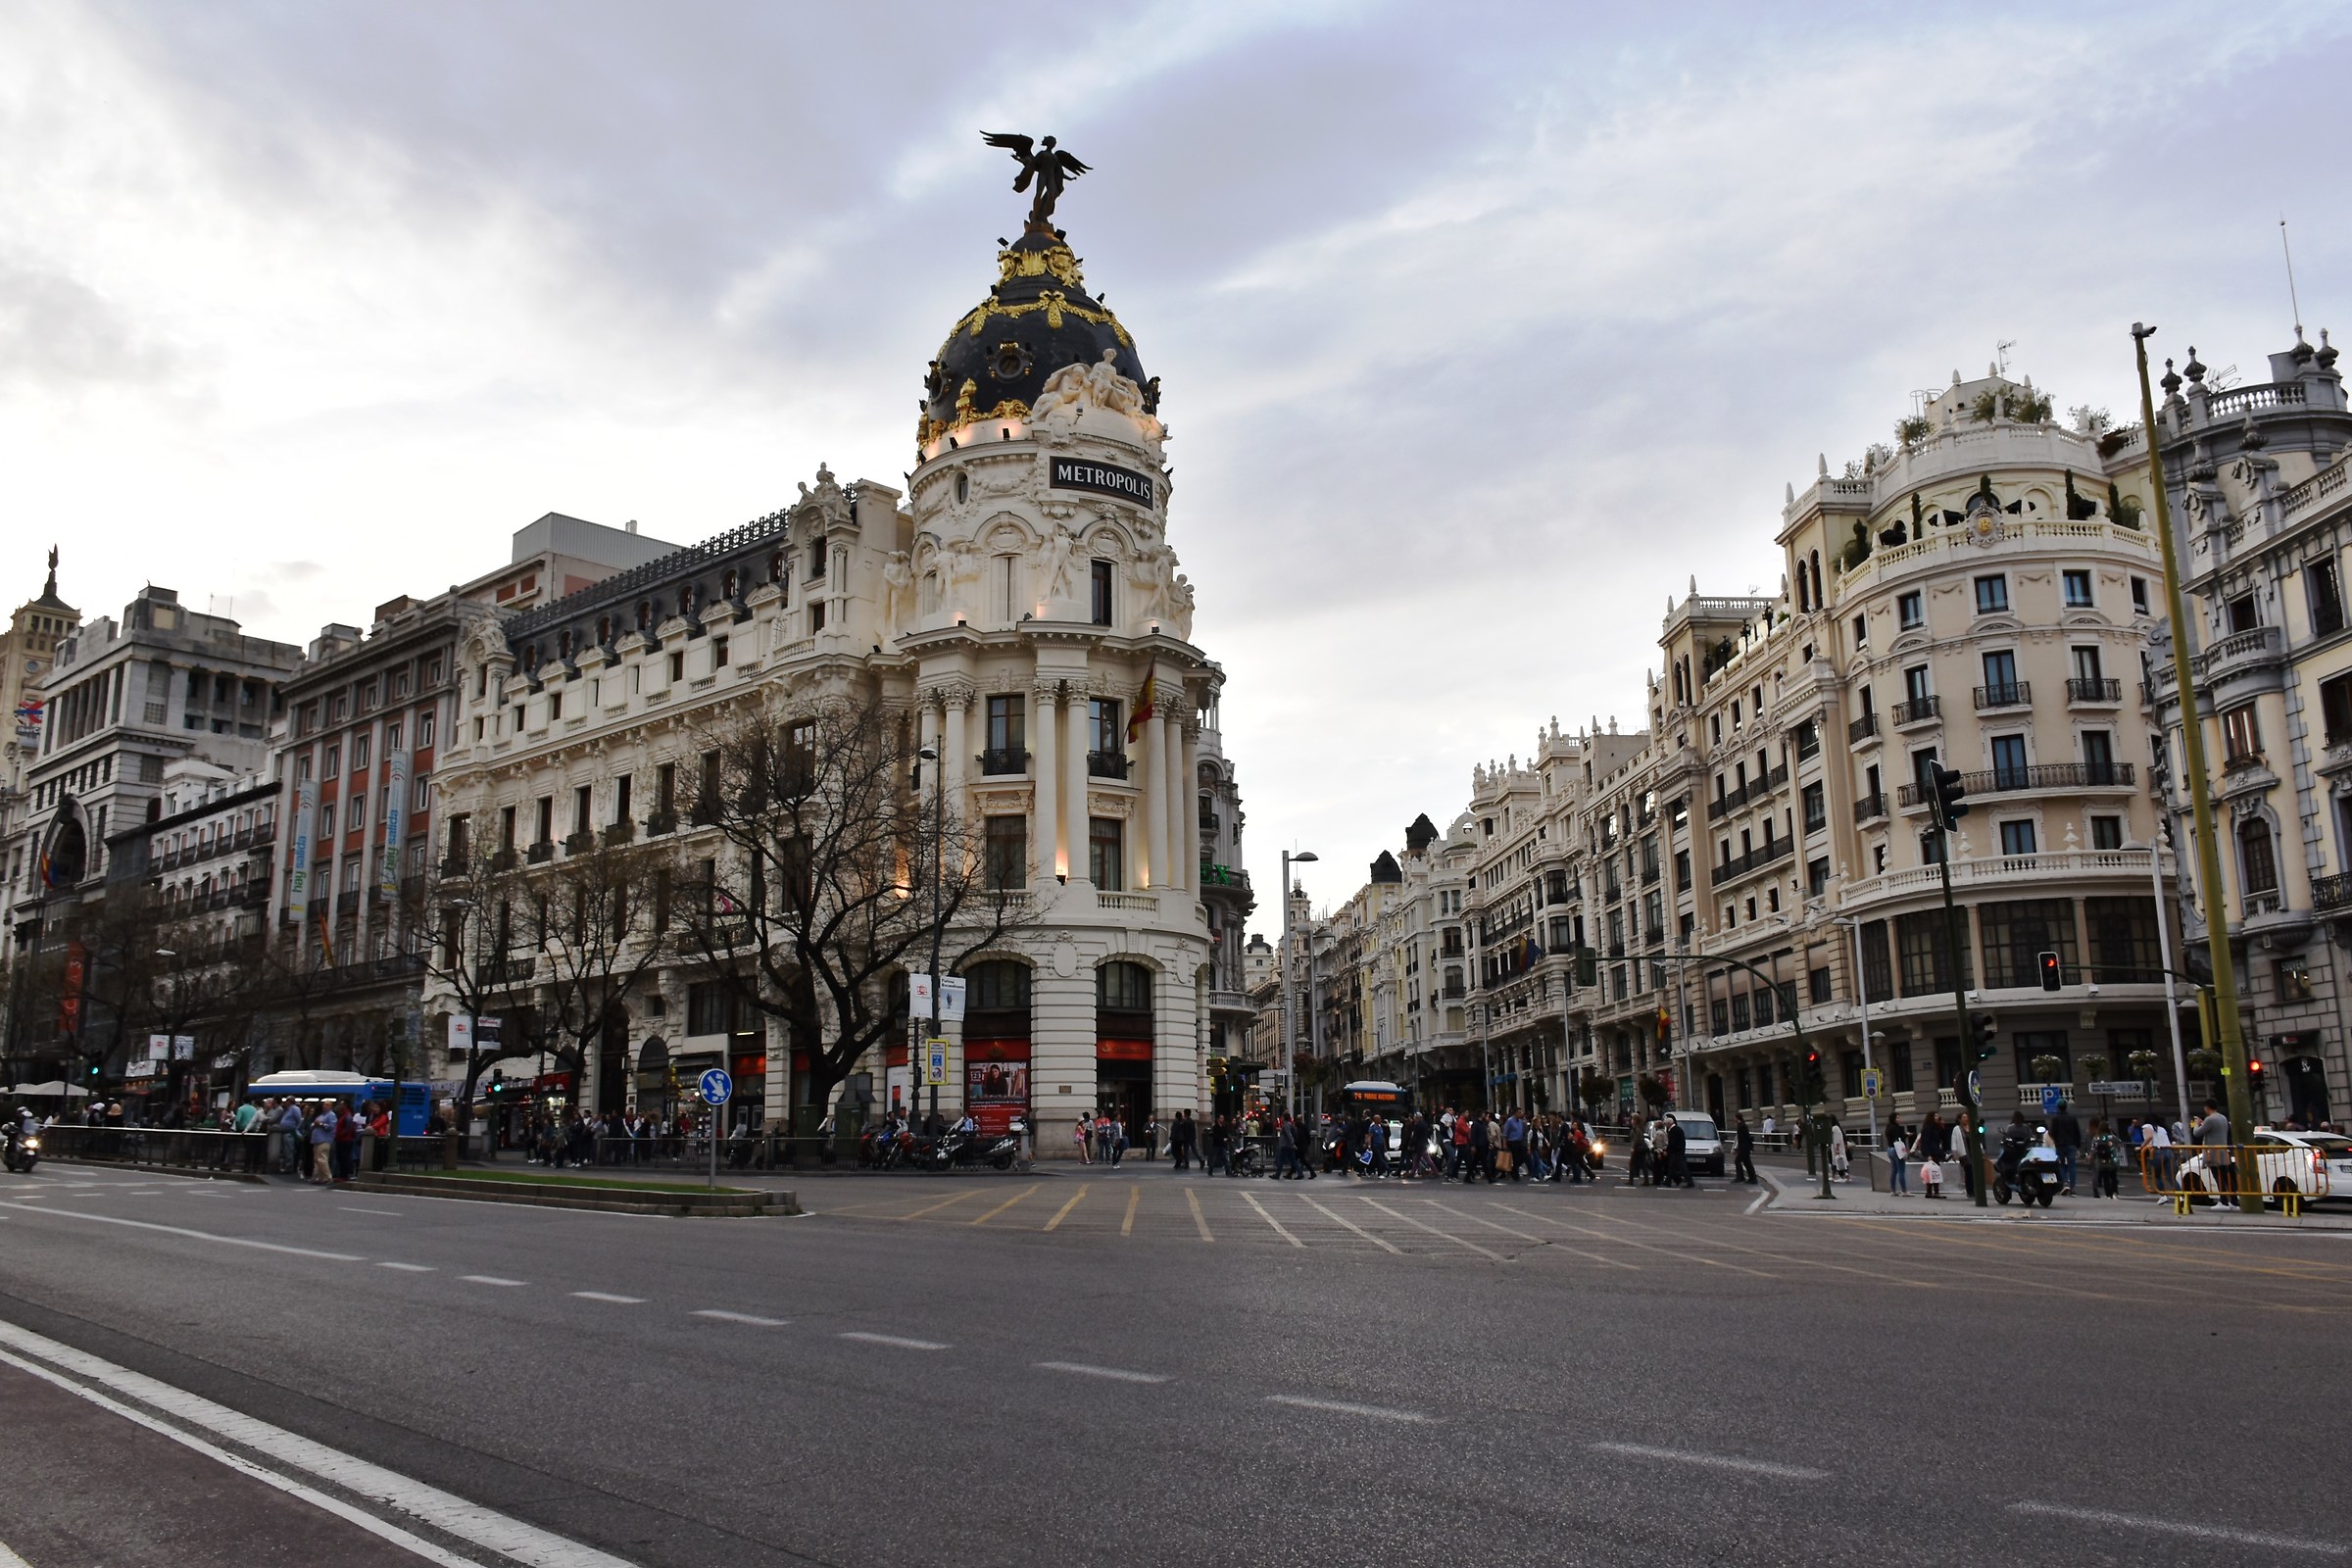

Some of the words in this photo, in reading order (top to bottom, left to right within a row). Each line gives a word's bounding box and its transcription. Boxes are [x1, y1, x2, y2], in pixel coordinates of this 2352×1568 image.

[1058, 464, 1151, 500] METROPOLIS
[386, 809, 399, 846] salida
[294, 835, 307, 869] salida
[384, 847, 399, 871] hay
[291, 870, 307, 894] hay
[2043, 1089, 2054, 1102] P
